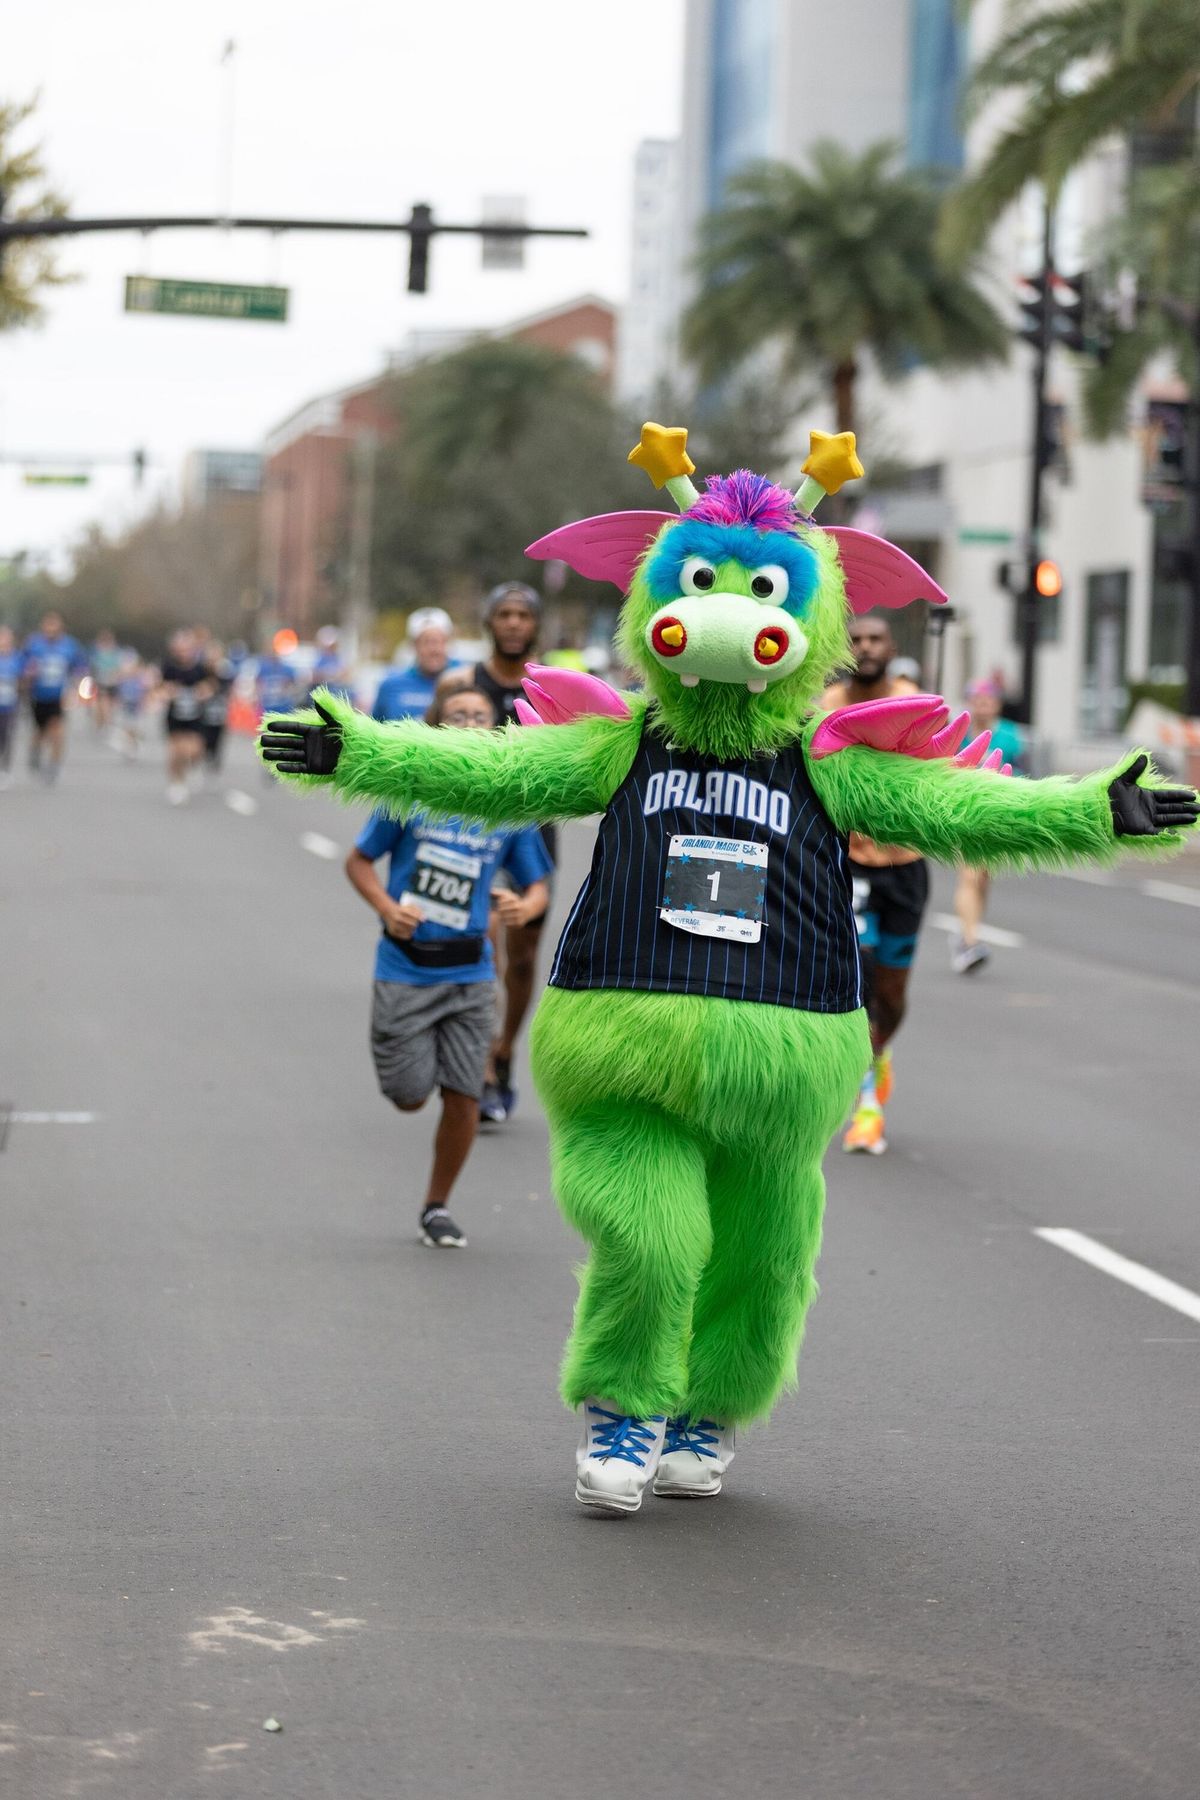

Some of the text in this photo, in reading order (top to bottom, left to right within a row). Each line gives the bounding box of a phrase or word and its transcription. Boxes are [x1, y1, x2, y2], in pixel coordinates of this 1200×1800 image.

[644, 770, 791, 835] ORLANDO
[681, 838, 715, 849] ORLANDO
[714, 841, 740, 852] MAGIC
[417, 868, 472, 905] 1704
[707, 871, 720, 901] 1
